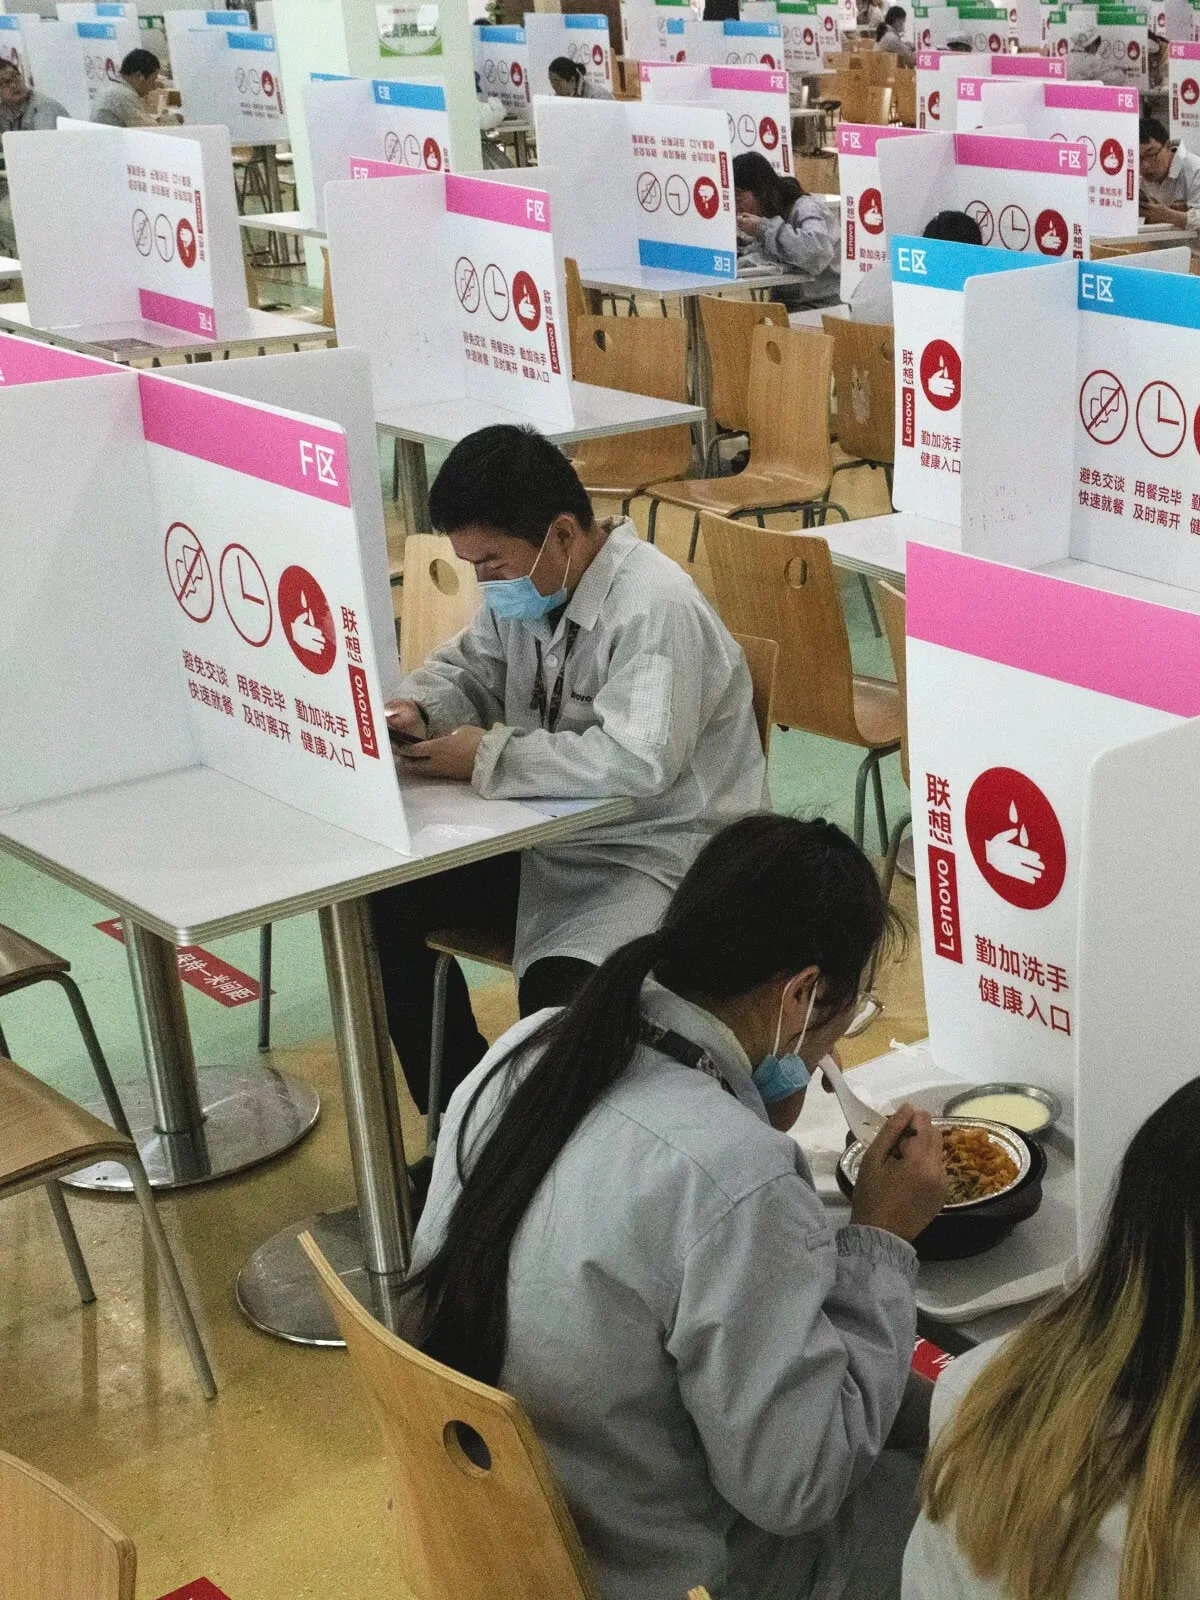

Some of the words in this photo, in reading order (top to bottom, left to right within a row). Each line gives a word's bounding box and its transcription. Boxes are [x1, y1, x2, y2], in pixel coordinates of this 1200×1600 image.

[1171, 45, 1185, 57] F区
[770, 74, 785, 89] F区
[960, 83, 975, 96] F区
[1118, 93, 1134, 108] F区
[841, 131, 862, 149] F区
[1059, 150, 1081, 169] F区
[526, 199, 546, 222] F区
[846, 224, 855, 259] Lenovo
[1073, 223, 1083, 249] 联想
[714, 255, 731, 272] E区
[898, 247, 928, 275] E区
[1081, 273, 1114, 303] E区
[547, 327, 559, 370] Lenovo
[902, 349, 914, 385] 联想
[904, 391, 914, 444] Lenovo
[920, 429, 961, 455] 勤加洗手
[299, 439, 339, 487] F区
[920, 450, 961, 476] 健康入口
[1078, 466, 1126, 494] 避免交谈
[1134, 479, 1182, 506] 用餐完毕
[1078, 489, 1124, 517] 快速就餐
[1132, 503, 1182, 531] 及时离开
[340, 605, 364, 665] 联想
[182, 649, 230, 689] 避免交谈
[236, 673, 287, 712] 用餐完毕
[294, 697, 350, 739] 勤加洗手
[188, 679, 235, 718] 快速就餐
[241, 703, 292, 744] 及时离开
[300, 728, 357, 772] 健康入口
[353, 673, 375, 753] Lenovo
[925, 772, 953, 845] 联想
[937, 858, 957, 953] Lenovo
[974, 933, 1070, 994] 勤加洗手
[976, 975, 1073, 1037] 健康入口
